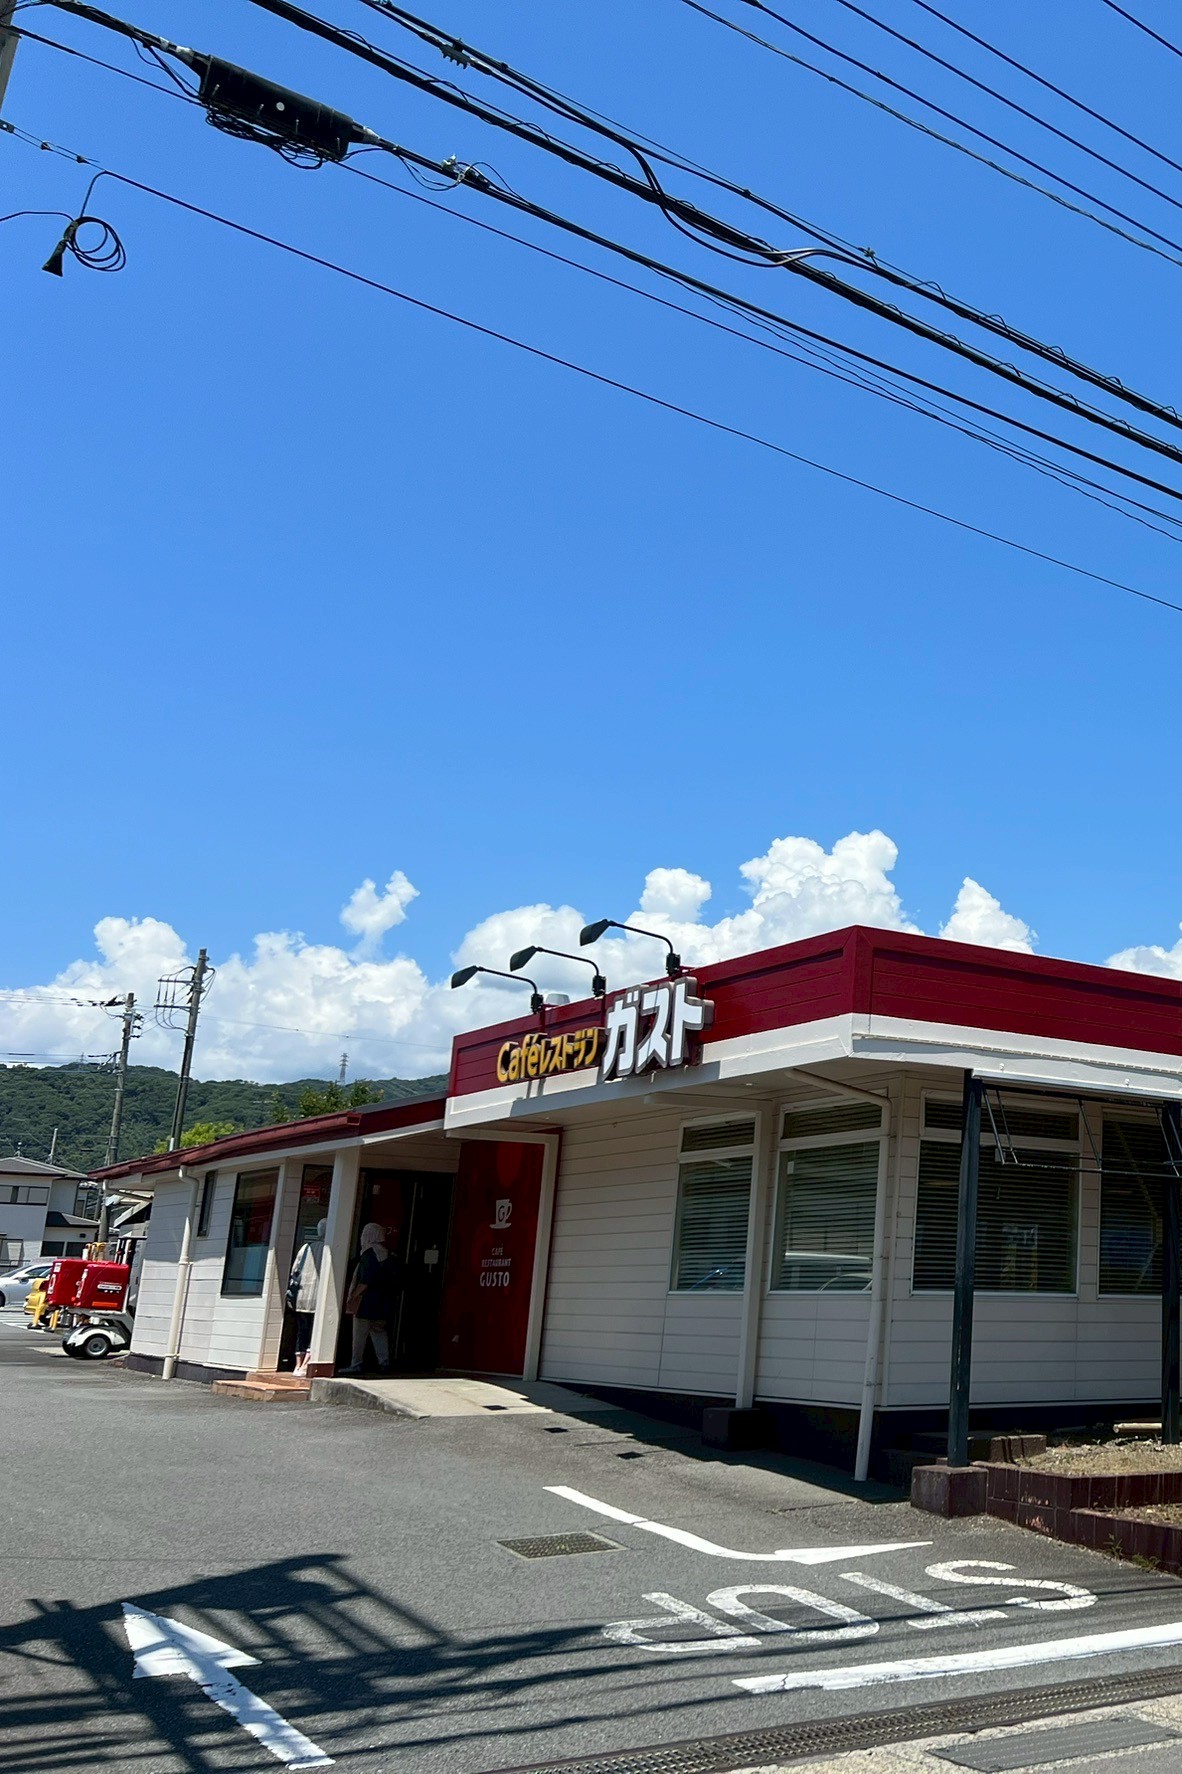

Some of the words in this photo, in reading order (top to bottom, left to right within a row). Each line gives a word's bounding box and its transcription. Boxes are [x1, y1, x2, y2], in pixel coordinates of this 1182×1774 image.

[602, 979, 706, 1080] ガスト
[479, 1271, 510, 1287] GUSTO
[602, 1559, 1098, 1652] STOP
